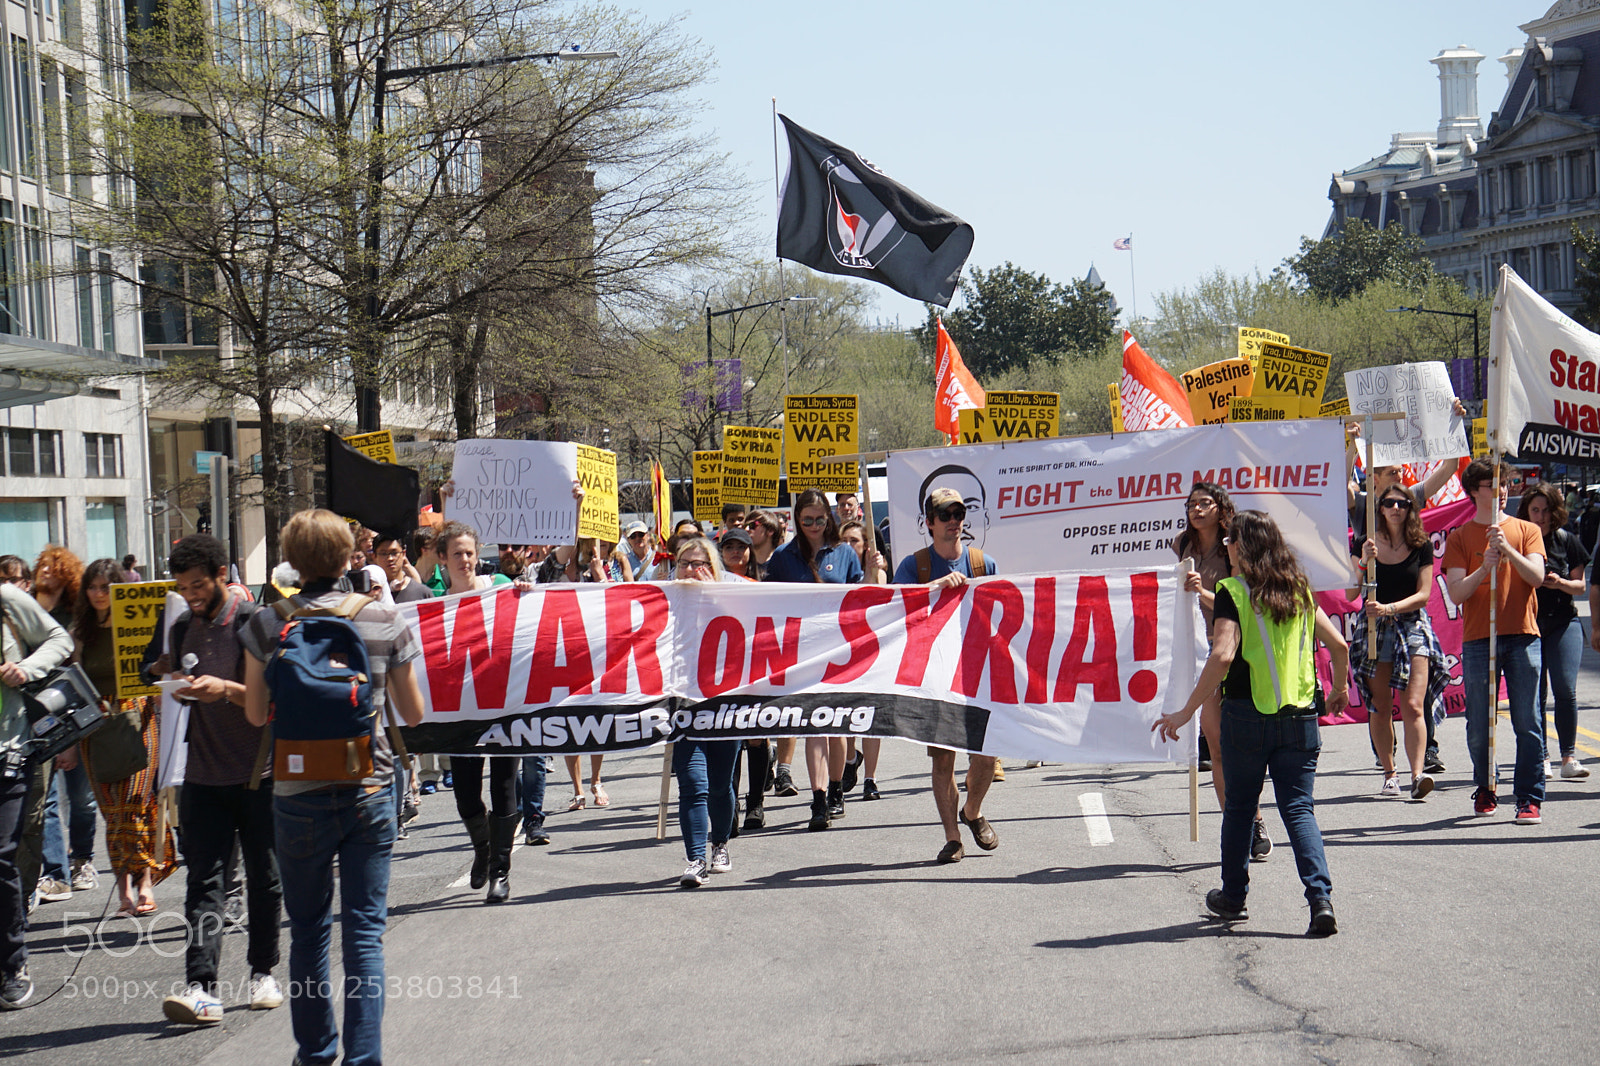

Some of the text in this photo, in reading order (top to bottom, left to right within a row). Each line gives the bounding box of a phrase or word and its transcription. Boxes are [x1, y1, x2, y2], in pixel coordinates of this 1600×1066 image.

[1241, 329, 1288, 345] BOMBING
[1306, 353, 1327, 366] Syria:
[1262, 358, 1324, 380] ENDLESS
[1550, 348, 1600, 394] Sta
[1183, 363, 1251, 393] Palestine
[1264, 371, 1318, 398] WAR
[1355, 363, 1446, 396] NO SAFE
[788, 398, 855, 409] Iraq, Libya, Syria:
[988, 394, 1056, 406] Iraq, Libya, Syria:
[1356, 394, 1418, 416] SPACE
[788, 411, 854, 423] ENDLESS
[989, 407, 1055, 420] ENDLESS
[1232, 407, 1285, 420] USS Maine
[1553, 398, 1600, 434] wa
[726, 428, 781, 441] BOMBING
[792, 423, 851, 442] WAR
[992, 419, 1051, 438] WAR
[1393, 415, 1423, 441] US
[730, 440, 775, 454] SYRIA
[808, 448, 836, 458] FOR
[1370, 433, 1468, 463] MPERIALISM
[725, 454, 779, 466] Doesn't Protect
[789, 461, 856, 475] EMPIRE
[998, 468, 1008, 476] IN
[1009, 466, 1025, 474] THE
[1025, 464, 1052, 473] SPIRIT
[1052, 462, 1064, 470] OF
[1064, 461, 1078, 469] DR.
[477, 457, 532, 487] STOP
[723, 466, 750, 476] People.
[576, 469, 613, 495] WAR
[722, 476, 778, 491] KILLS THEM
[997, 462, 1331, 510] FIGHT the WAR MACHINE!
[455, 487, 538, 511] BOMBING
[587, 495, 605, 507] FOR
[696, 496, 720, 507] KILLS
[582, 506, 617, 525] MPIRE
[1063, 517, 1187, 539] OPPOSE RACISM &
[1090, 543, 1109, 556] AT
[1112, 540, 1152, 554] HOME
[416, 571, 1159, 713] WAR ON SYRIA!
